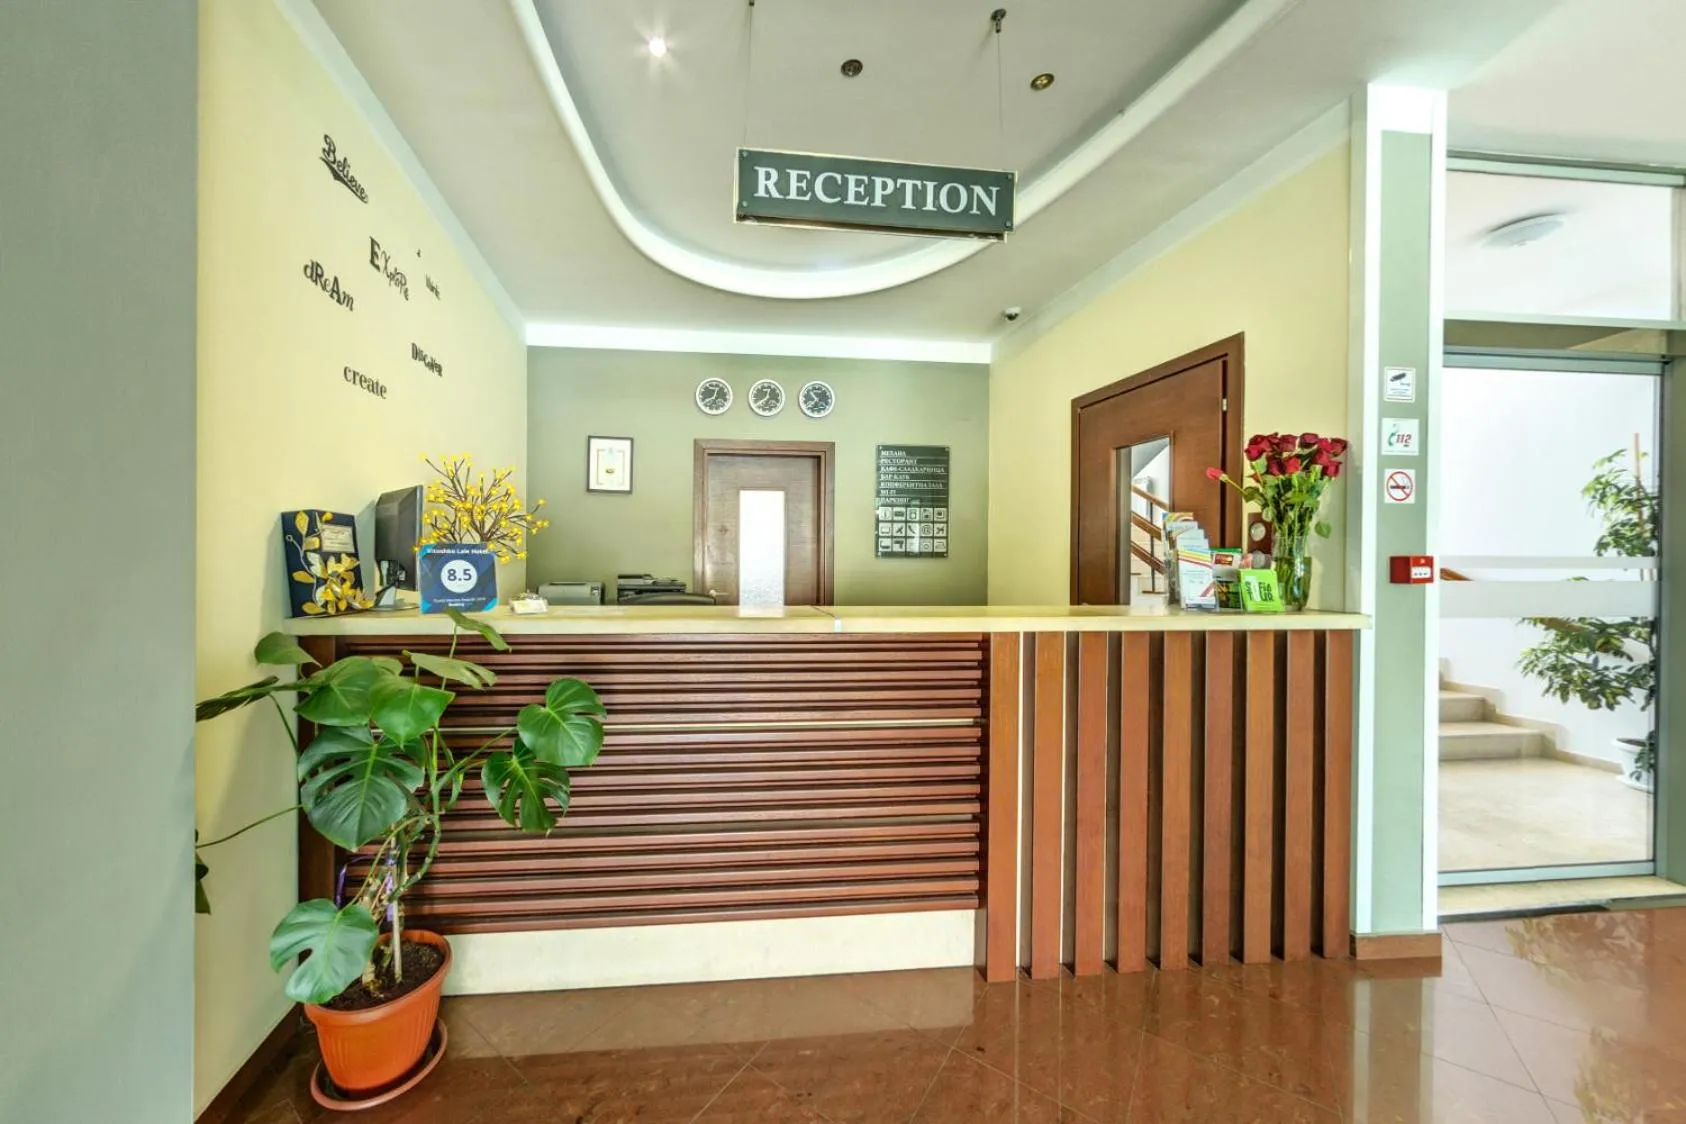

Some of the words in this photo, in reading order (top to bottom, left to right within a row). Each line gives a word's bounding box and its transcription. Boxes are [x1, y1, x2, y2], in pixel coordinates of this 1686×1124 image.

[319, 134, 369, 203] Believe
[753, 165, 1000, 216] RECEPTION
[343, 365, 388, 400] create
[1395, 433, 1412, 444] 112
[447, 568, 472, 581] 8.5
